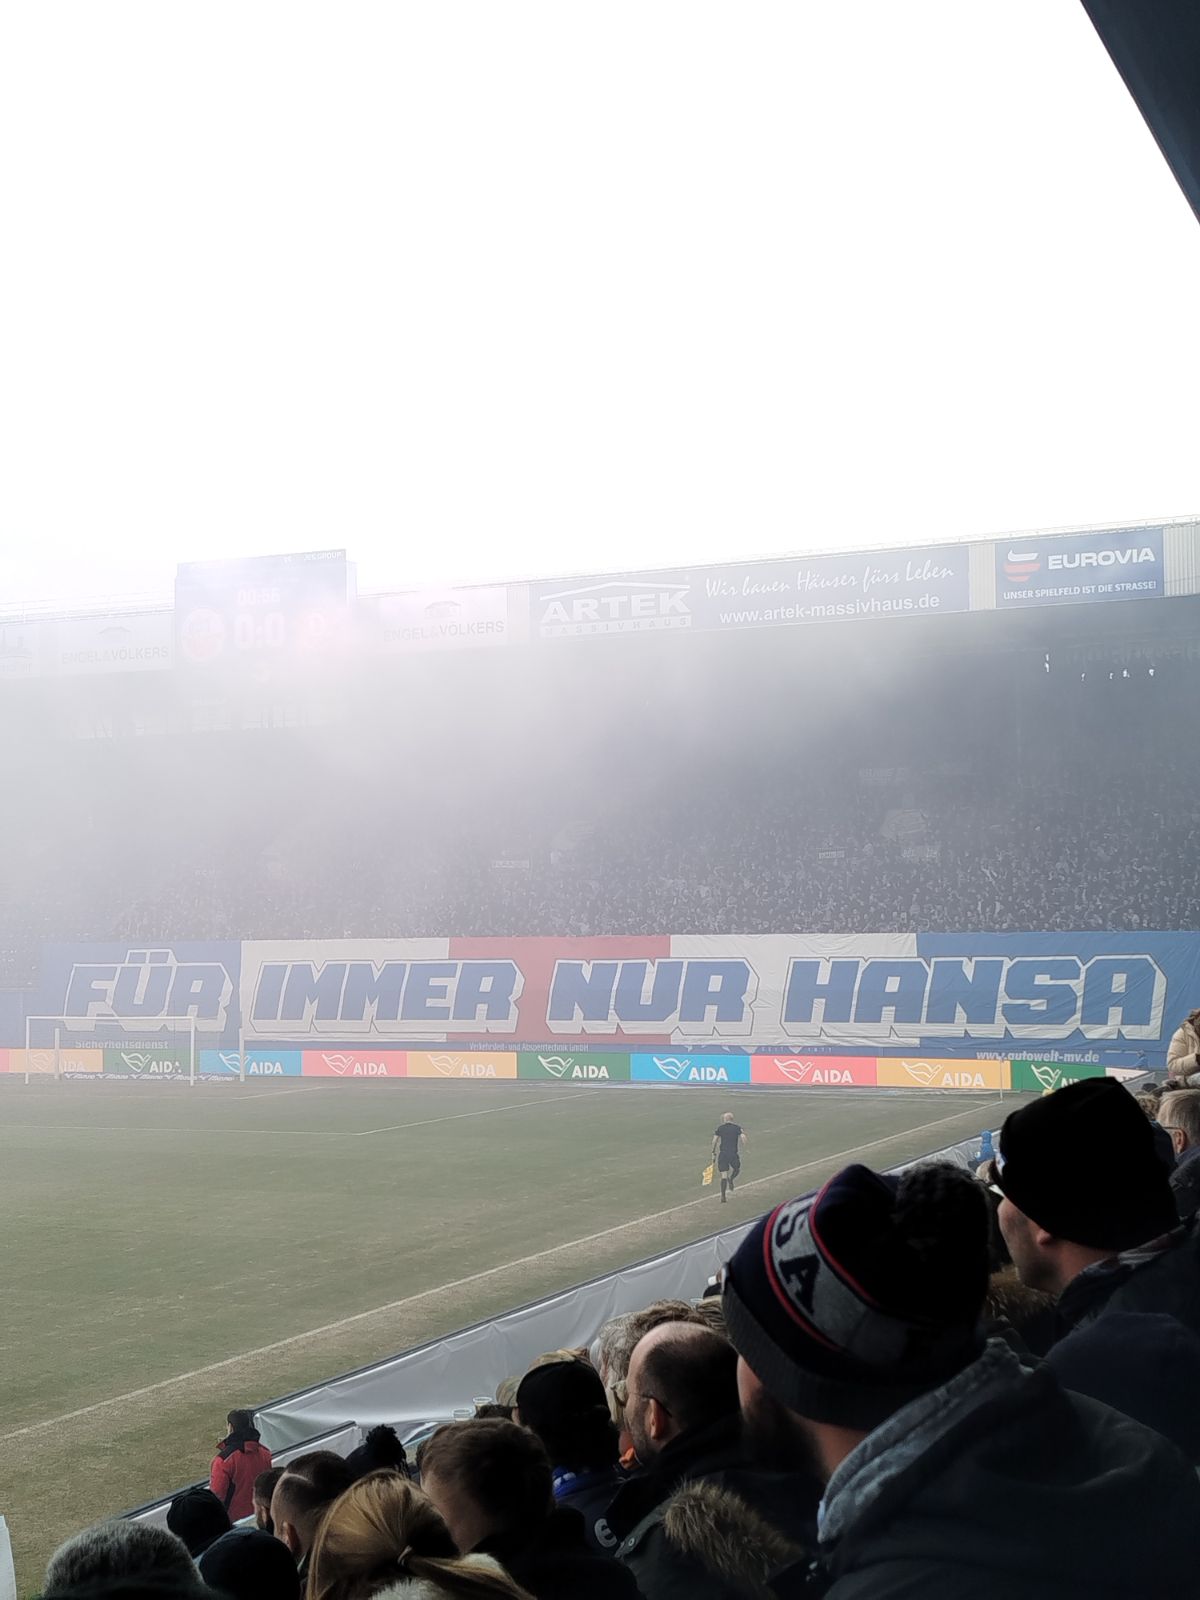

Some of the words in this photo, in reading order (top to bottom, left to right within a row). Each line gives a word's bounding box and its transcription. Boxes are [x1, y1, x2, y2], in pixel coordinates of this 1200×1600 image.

[1048, 547, 1156, 570] EUROVIA
[705, 577, 738, 597] Wir
[742, 575, 791, 597] bauen
[797, 570, 858, 592] Häuser
[863, 565, 901, 592] fürs
[905, 559, 956, 583] Leben
[1003, 590, 1033, 600] UNSER
[1035, 585, 1080, 599] SPIELFELD
[1082, 584, 1096, 595] IST
[1098, 583, 1113, 594] DIE
[1115, 580, 1157, 593] STRASSE!
[541, 590, 691, 623] ARTEK
[719, 593, 941, 624] www.artek-massivhaus.de
[234, 611, 287, 650] 0:0
[544, 615, 688, 635] MASSIVHAUS
[64, 949, 233, 1031] FÜR
[249, 959, 525, 1034] IMMER
[545, 957, 759, 1037] NUR
[780, 954, 1167, 1041] HANSA
[249, 1061, 284, 1074] AIDA
[352, 1063, 388, 1076] AIDA
[460, 1064, 497, 1077] AIDA
[571, 1065, 610, 1079] AIDA
[688, 1067, 729, 1081] AIDA
[811, 1069, 853, 1084] AIDA
[942, 1072, 986, 1088] AIDA
